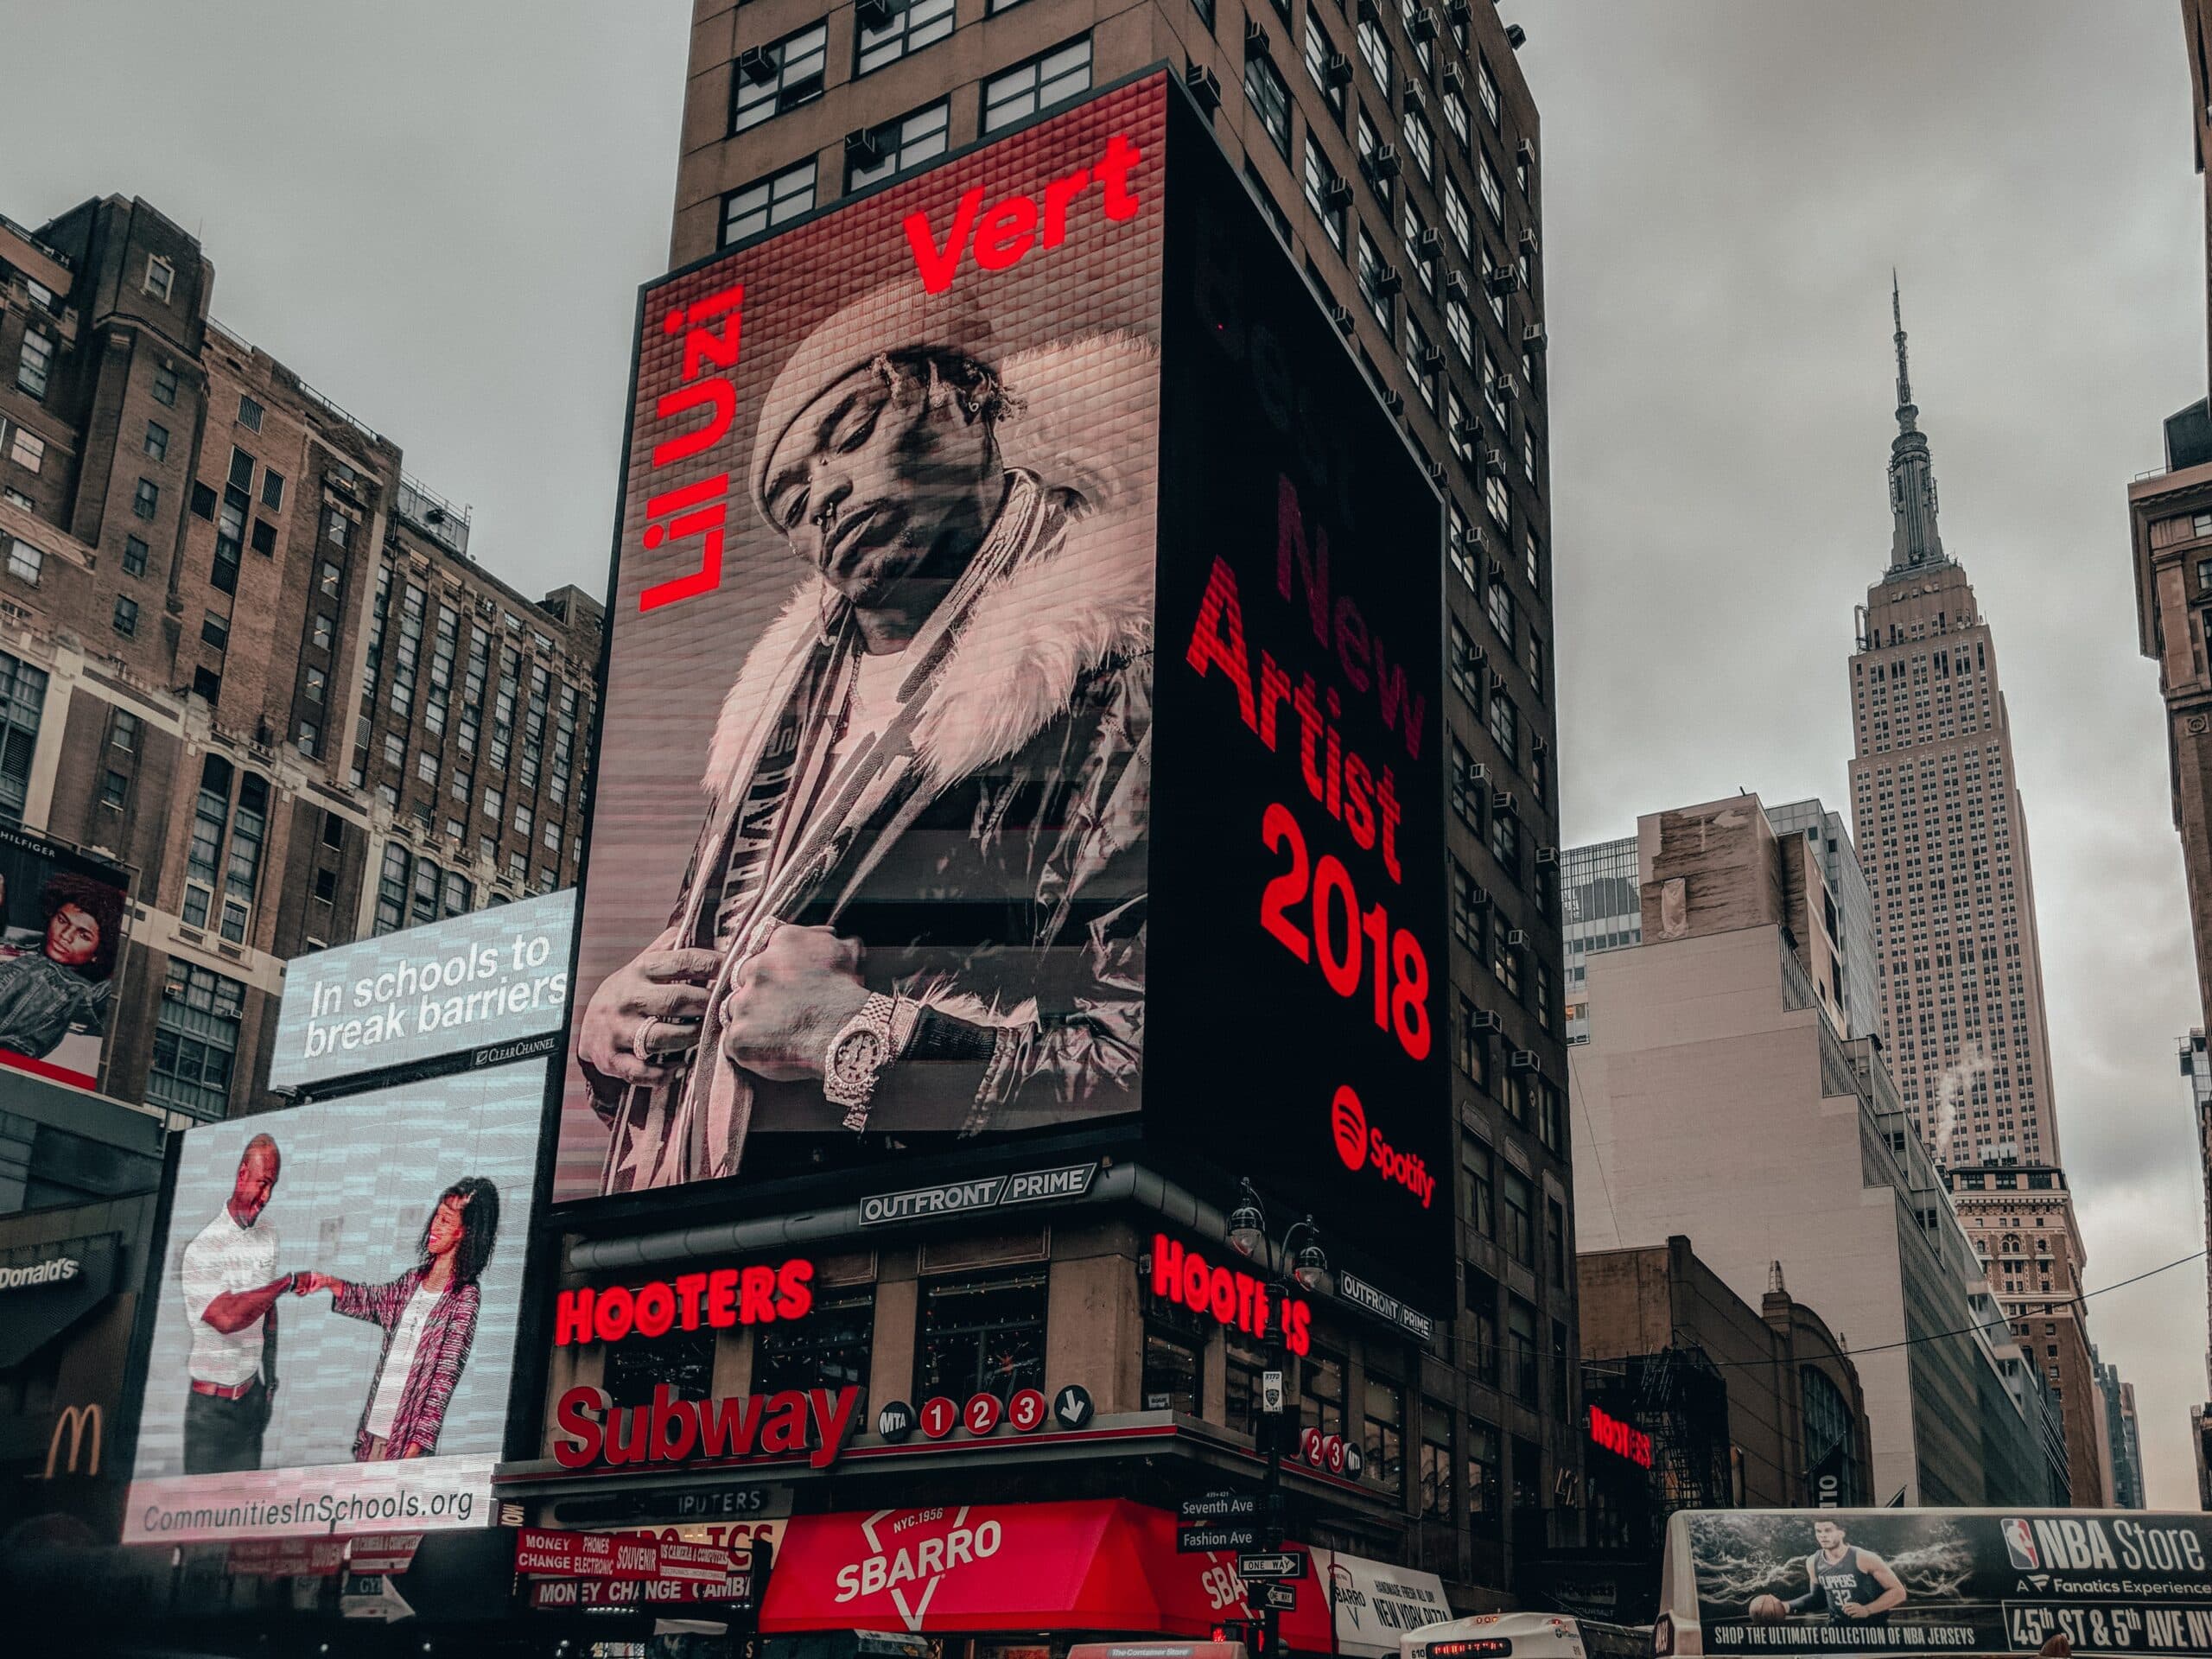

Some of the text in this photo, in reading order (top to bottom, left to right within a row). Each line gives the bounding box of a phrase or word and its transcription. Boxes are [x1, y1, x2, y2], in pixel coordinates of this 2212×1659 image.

[902, 133, 1141, 296] Vert
[639, 283, 745, 613] Lil Uzi
[1277, 473, 1425, 760] New
[1185, 554, 1402, 885] Artist
[0, 831, 55, 857] HILFIGER
[1261, 802, 1431, 1061] 2018
[310, 934, 550, 1018] In schools to
[304, 972, 568, 1058] break barriers
[1370, 1127, 1435, 1209] Spotify
[866, 1169, 1084, 1221] OUTFRONT PRIME
[555, 1258, 815, 1346] HOOTERS
[1344, 1275, 1429, 1336] OUTFRONT PRIME
[554, 1382, 1034, 1469] Subway MTA 1 2 3
[1311, 1435, 1319, 1459] 2
[1332, 1442, 1340, 1466] 3
[144, 1490, 474, 1532] CommunitiesInSchools.org
[1182, 1499, 1253, 1515] Seventh Ave
[518, 1553, 570, 1569] CHANGE
[525, 1535, 570, 1551] MONEY
[582, 1535, 610, 1554] PHONES
[617, 1545, 657, 1572] SOUVENIR
[834, 1520, 1001, 1603] SBARRO
[1184, 1531, 1253, 1547] Fashion Ave
[2032, 1519, 2205, 1572] NBA Store
[1272, 1560, 1290, 1569] WAY
[2016, 1578, 2212, 1597] A Fanatics Experience
[1372, 1598, 1401, 1629] NEW
[1397, 1603, 1425, 1630] YORK
[1715, 1626, 1975, 1645] SHOP THE ULTIMATE COLLECTION OF NBA JERSEYS
[2058, 1609, 2087, 1646] ST
[2089, 1609, 2113, 1646] &
[2145, 1610, 2189, 1647] AVE
